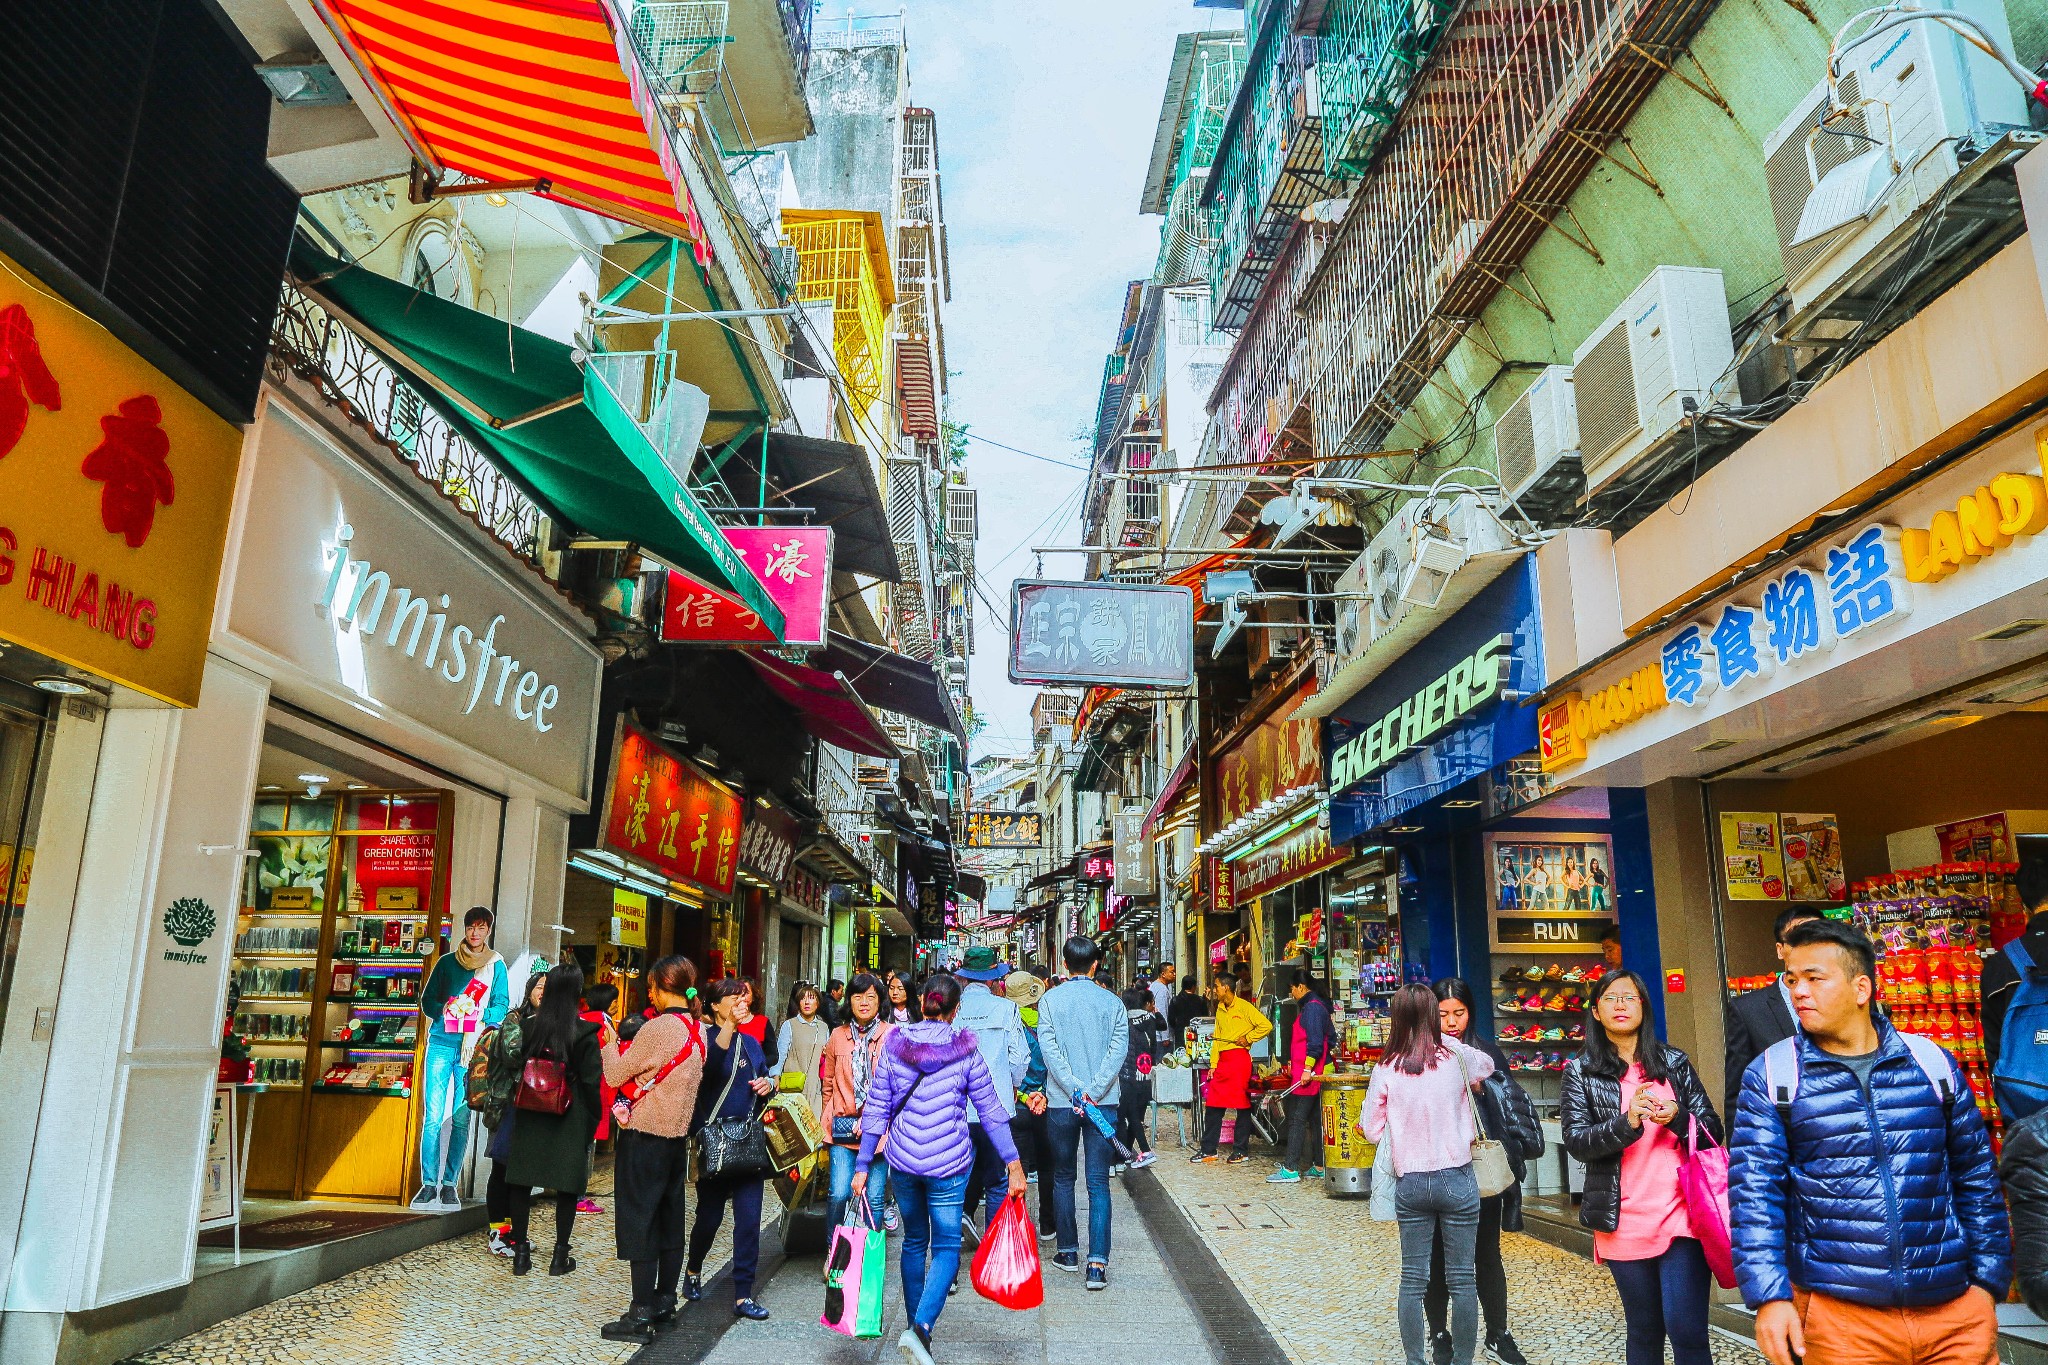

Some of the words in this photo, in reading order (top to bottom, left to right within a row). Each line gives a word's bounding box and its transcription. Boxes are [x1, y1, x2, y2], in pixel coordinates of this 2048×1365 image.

[1870, 28, 1911, 73] Panasonic
[1635, 302, 1658, 327] Panasonic
[1900, 473, 2034, 583] LAND
[26, 546, 158, 649] HIANG
[1660, 525, 1899, 708] 零食物語
[317, 523, 559, 733] innisfree
[1329, 633, 1503, 796] SKECHERS
[1575, 661, 1668, 740] OKASHI
[380, 835, 407, 846] SHARE
[408, 835, 430, 845] YOUR
[624, 769, 735, 886] 濠江手信
[364, 848, 393, 858] GREEN
[394, 848, 434, 858] CHRISTM
[1217, 860, 1232, 909] 正宗鳳城
[1944, 873, 1978, 885] Jagabee
[1533, 922, 1579, 940] RUN
[1876, 909, 1912, 922] Jagabee
[1924, 905, 1955, 919] Jagabee
[163, 948, 208, 965] innisfree
